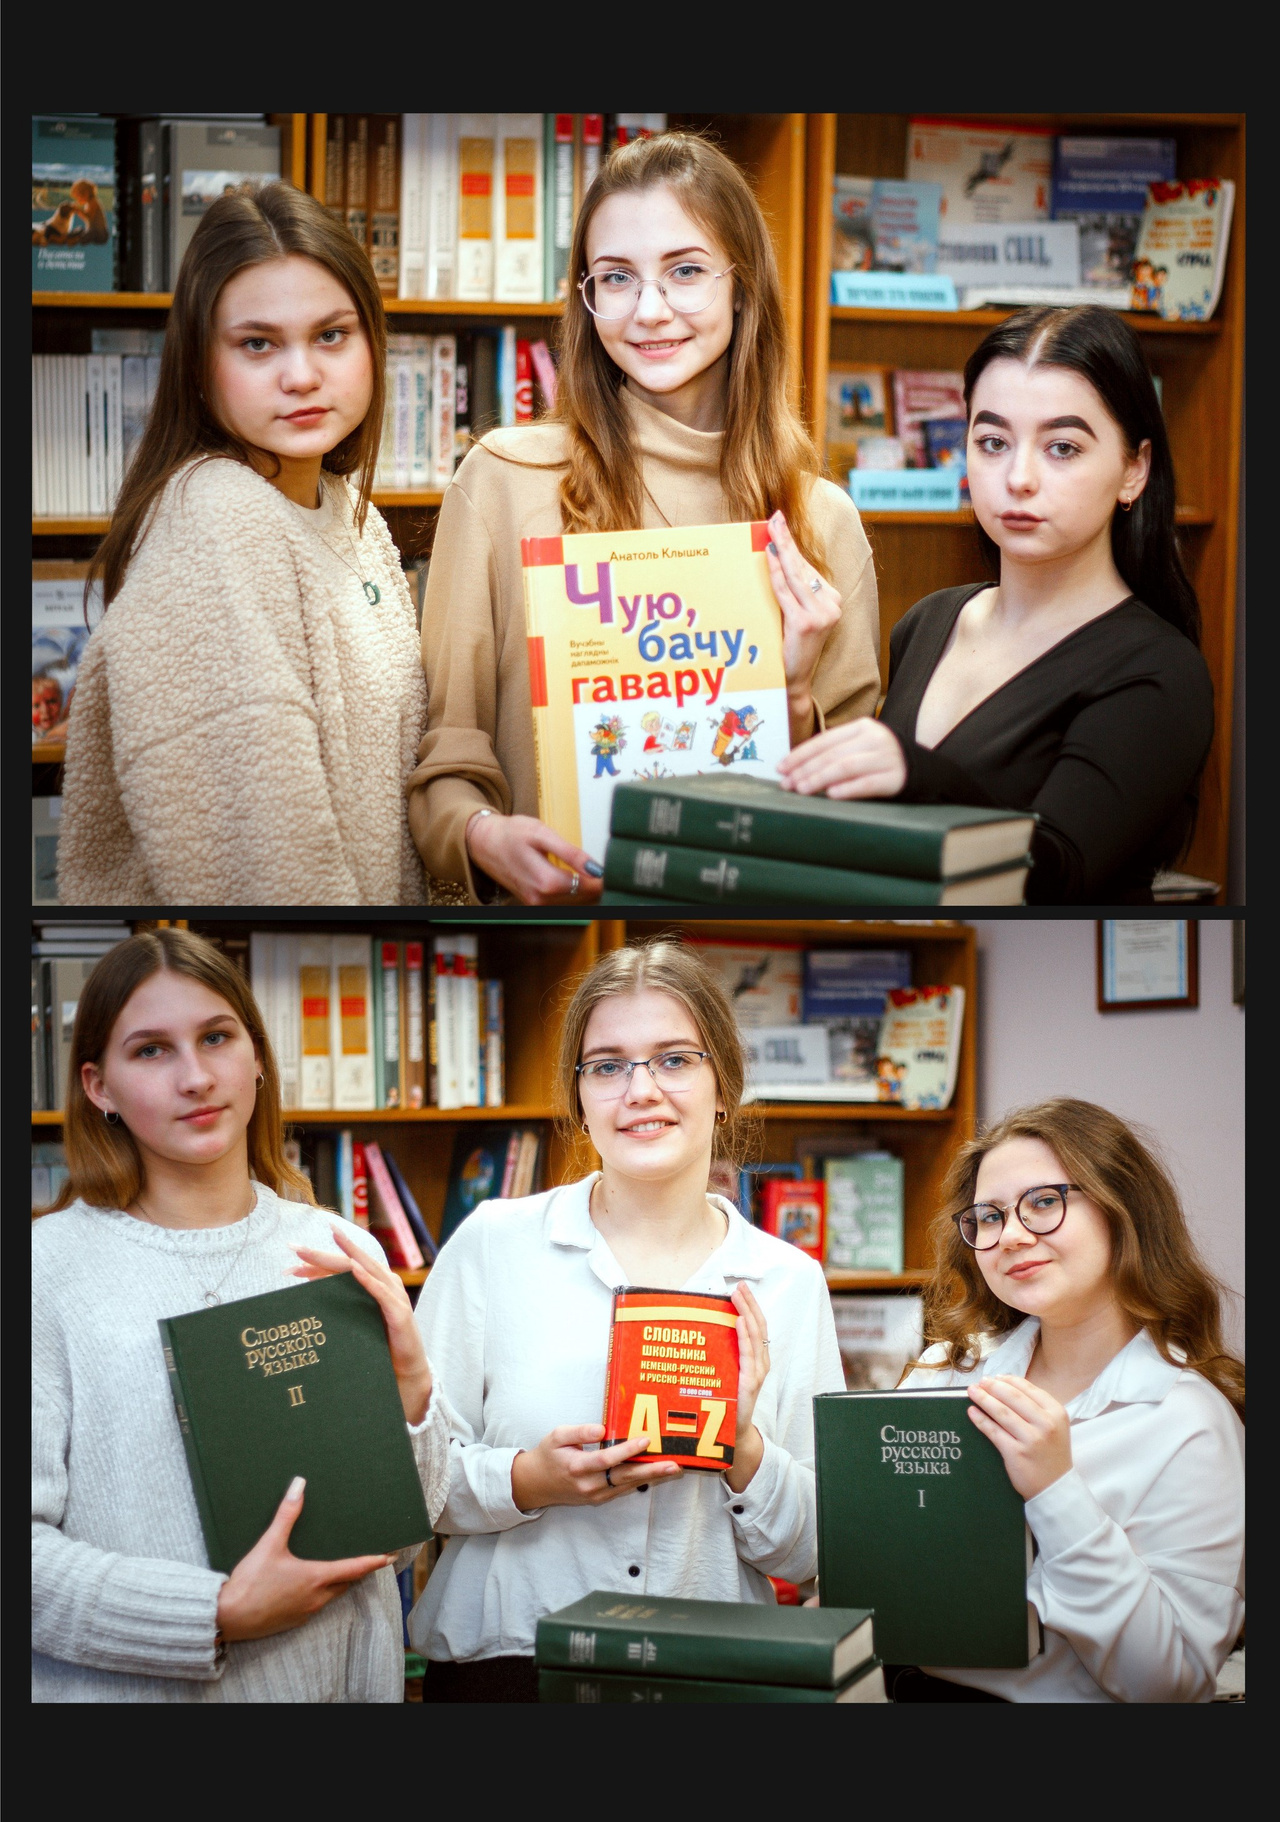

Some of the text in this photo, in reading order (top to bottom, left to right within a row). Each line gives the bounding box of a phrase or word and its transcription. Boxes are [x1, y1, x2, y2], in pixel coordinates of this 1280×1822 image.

[610, 548, 710, 562] Анатоль Клышка
[564, 561, 698, 634] Чую,
[570, 639, 606, 649] Вучэбны
[638, 620, 760, 668] бачу,
[570, 649, 610, 659] наглядны
[571, 658, 620, 668] дапаможнік
[572, 666, 726, 708] гавару
[240, 1316, 323, 1348] Словарь
[643, 1326, 706, 1346] СЛОВАРЬ
[245, 1331, 327, 1370] русского
[642, 1345, 707, 1362] ШКОЛЬНИКА
[263, 1350, 320, 1378] языка
[640, 1360, 716, 1376] НЕМЕЦКО-РУССКИЙ
[640, 1372, 722, 1388] И РУССКО-НЕМЕЦКИЙ
[288, 1385, 306, 1407] II
[880, 1424, 961, 1446] Словарь
[881, 1446, 962, 1462] русского
[894, 1461, 951, 1475] языка
[918, 1489, 926, 1508] I
